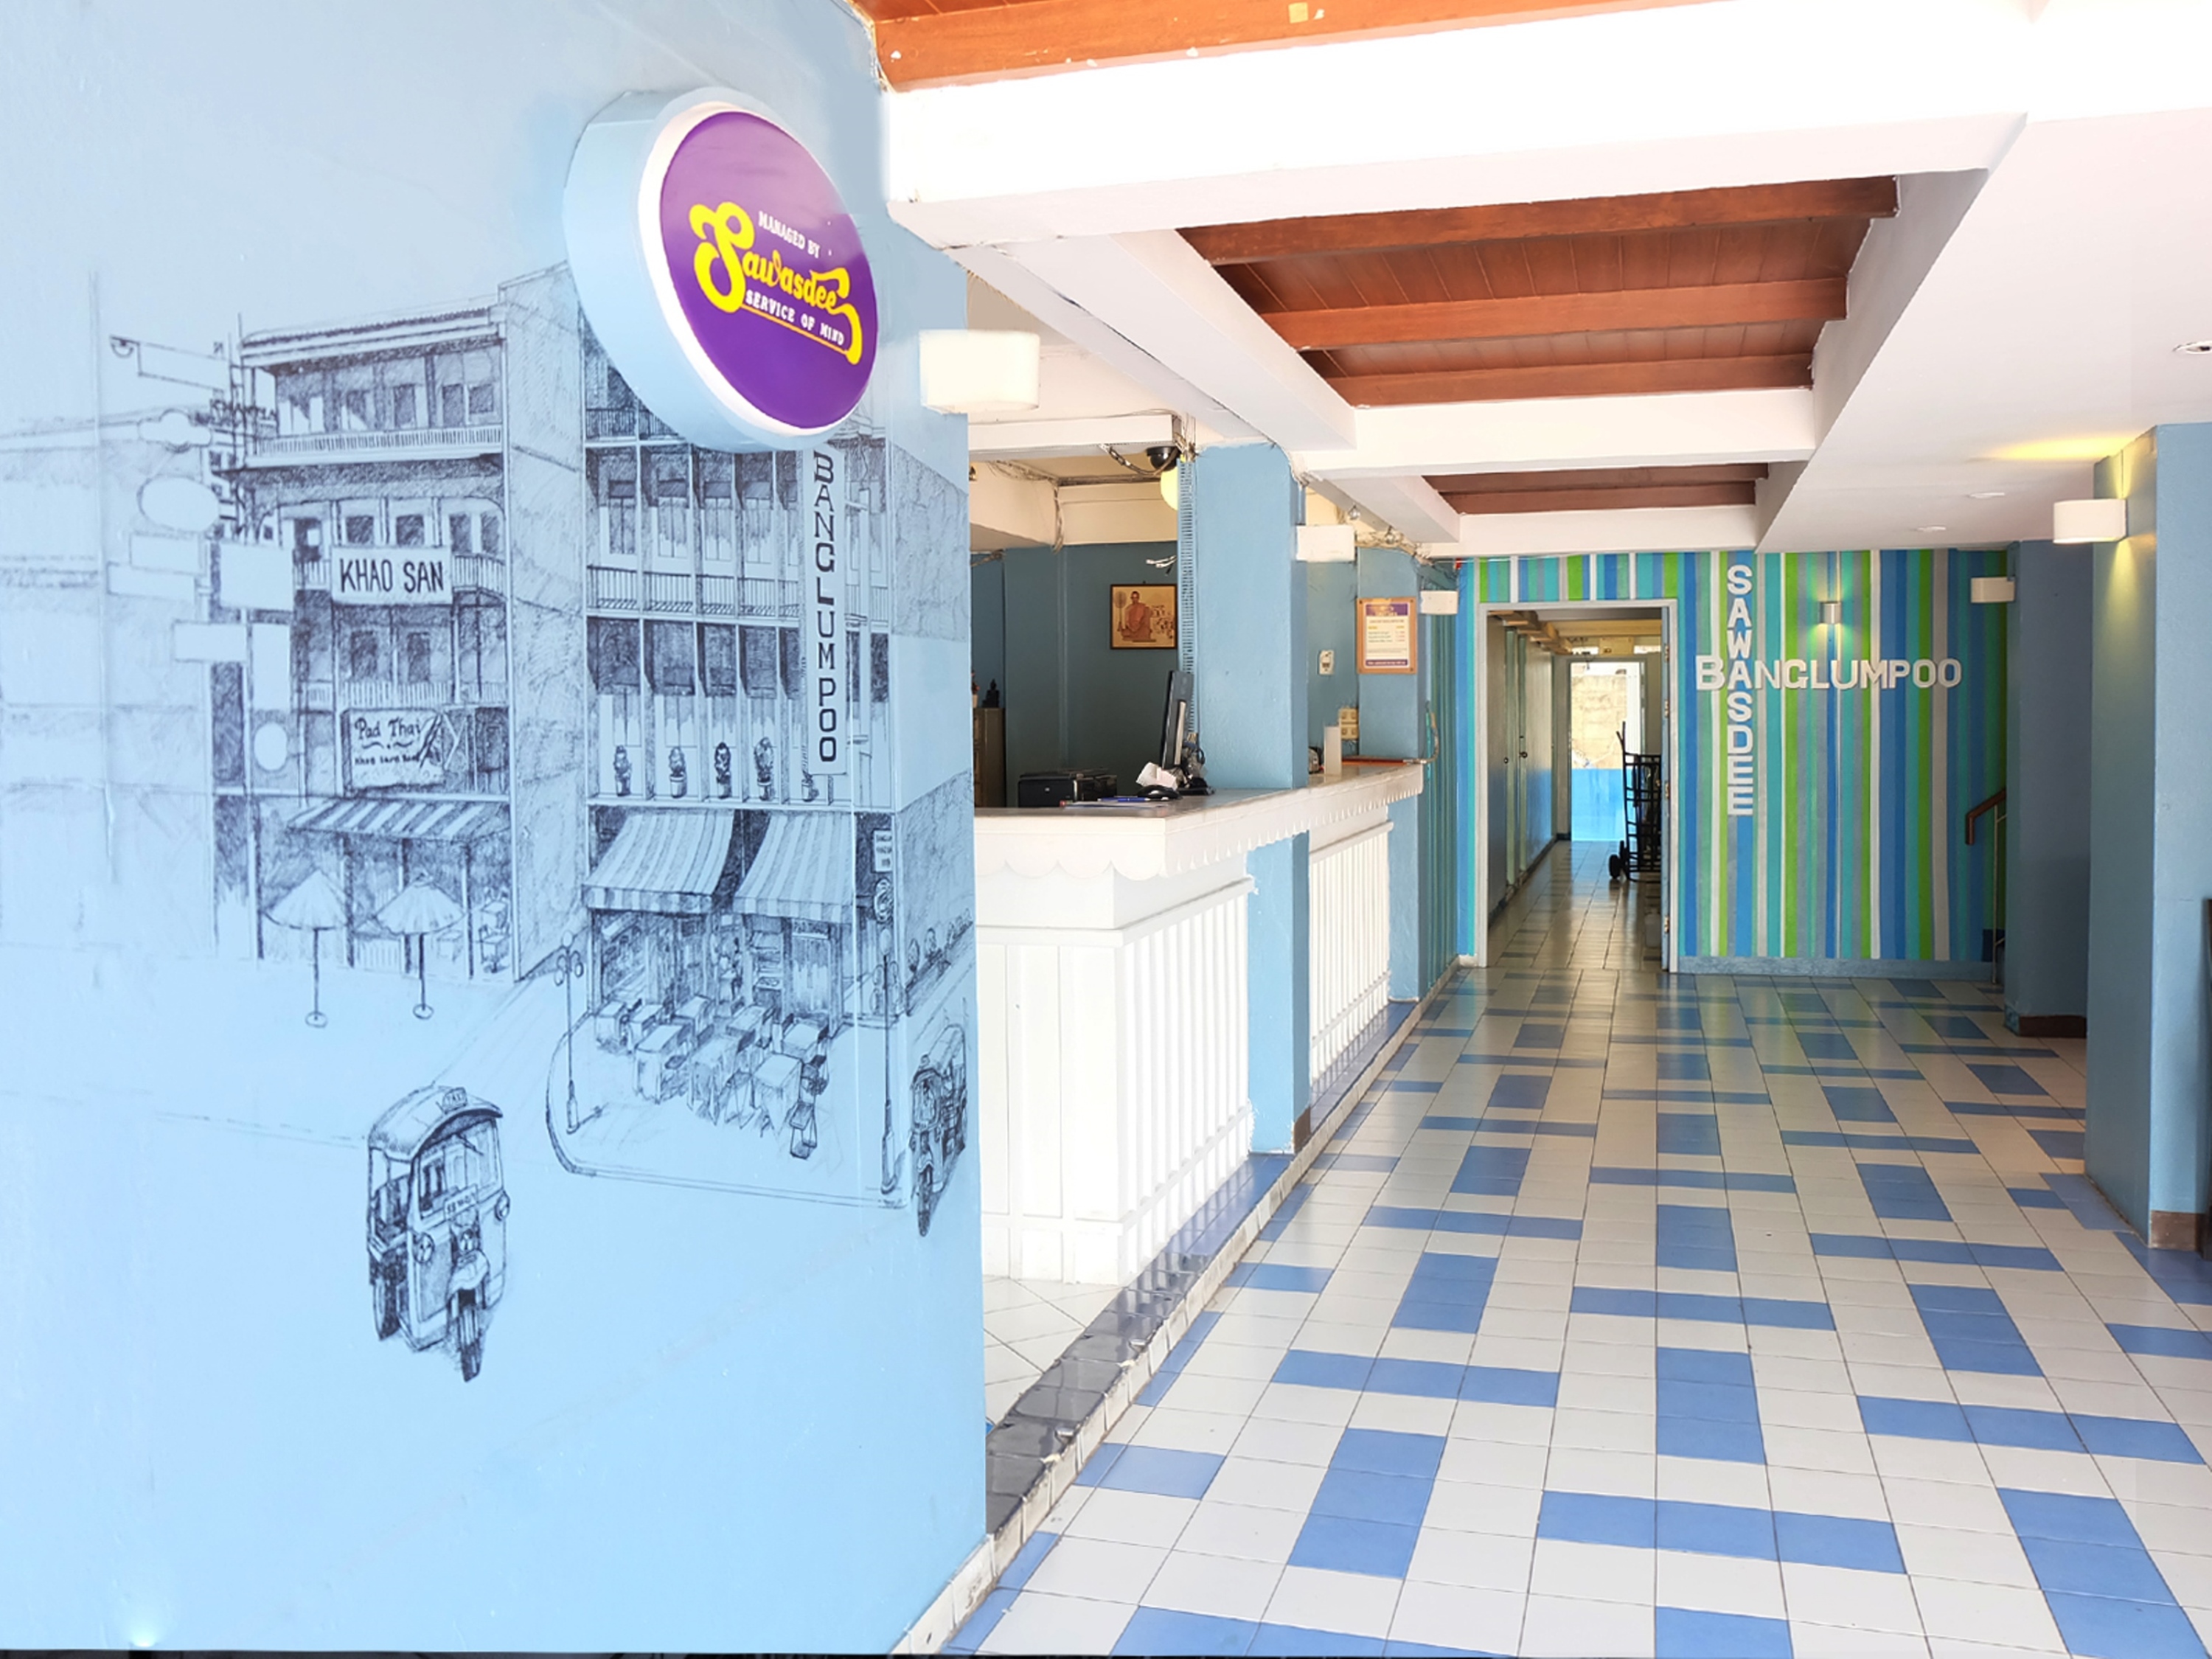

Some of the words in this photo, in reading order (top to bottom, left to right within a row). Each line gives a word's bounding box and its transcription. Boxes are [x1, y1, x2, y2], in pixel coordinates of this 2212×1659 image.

[758, 210, 805, 250] MANAGED
[807, 239, 821, 258] BY
[689, 201, 863, 364] Sawasdee
[745, 289, 796, 323] SERVICE
[801, 313, 815, 331] OF
[820, 322, 845, 346] MIND
[340, 558, 393, 592] KHAO
[403, 560, 444, 594] SAN
[813, 451, 837, 762] BANGLUMPOO
[1695, 654, 1963, 691] BANGLUMPOO
[1726, 564, 1754, 815] SAWASDEE
[355, 717, 381, 740] Pad
[388, 715, 421, 739] Thai
